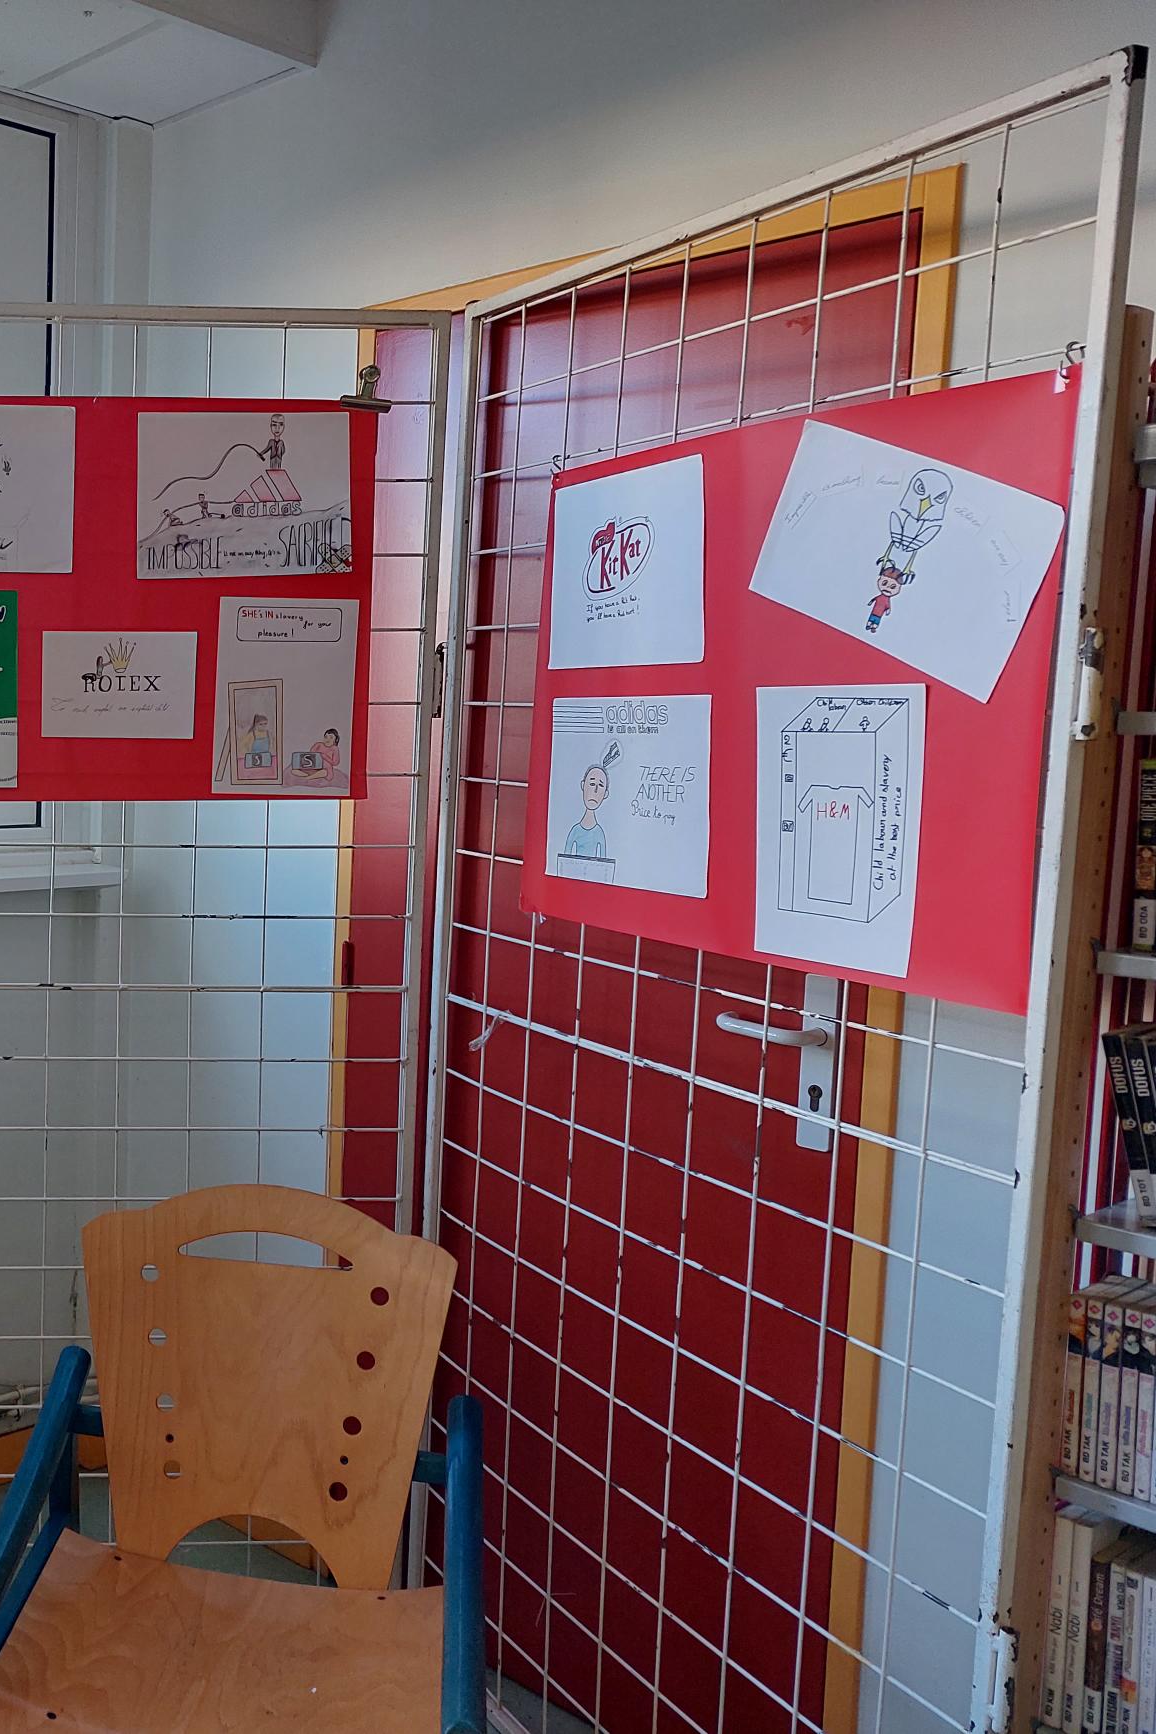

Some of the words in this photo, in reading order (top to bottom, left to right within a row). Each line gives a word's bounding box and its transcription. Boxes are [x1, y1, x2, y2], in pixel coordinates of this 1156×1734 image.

[232, 501, 302, 517] adidas
[606, 700, 669, 725] adidas
[639, 765, 679, 783] THERE
[681, 766, 697, 782] IS
[635, 784, 684, 803] ANOTHER
[816, 801, 850, 820] H&M
[872, 860, 884, 891] Child
[1063, 1428, 1072, 1446] TAK
[1083, 1434, 1091, 1450] TAK
[1063, 1447, 1071, 1460] BD
[1101, 1440, 1109, 1457] TAK
[1083, 1452, 1090, 1464] BD
[1100, 1459, 1108, 1472] BD
[1122, 1452, 1131, 1468] TAK
[1121, 1470, 1129, 1482] BD
[1049, 1607, 1063, 1635] Nabi
[1067, 1614, 1080, 1643] Nabi
